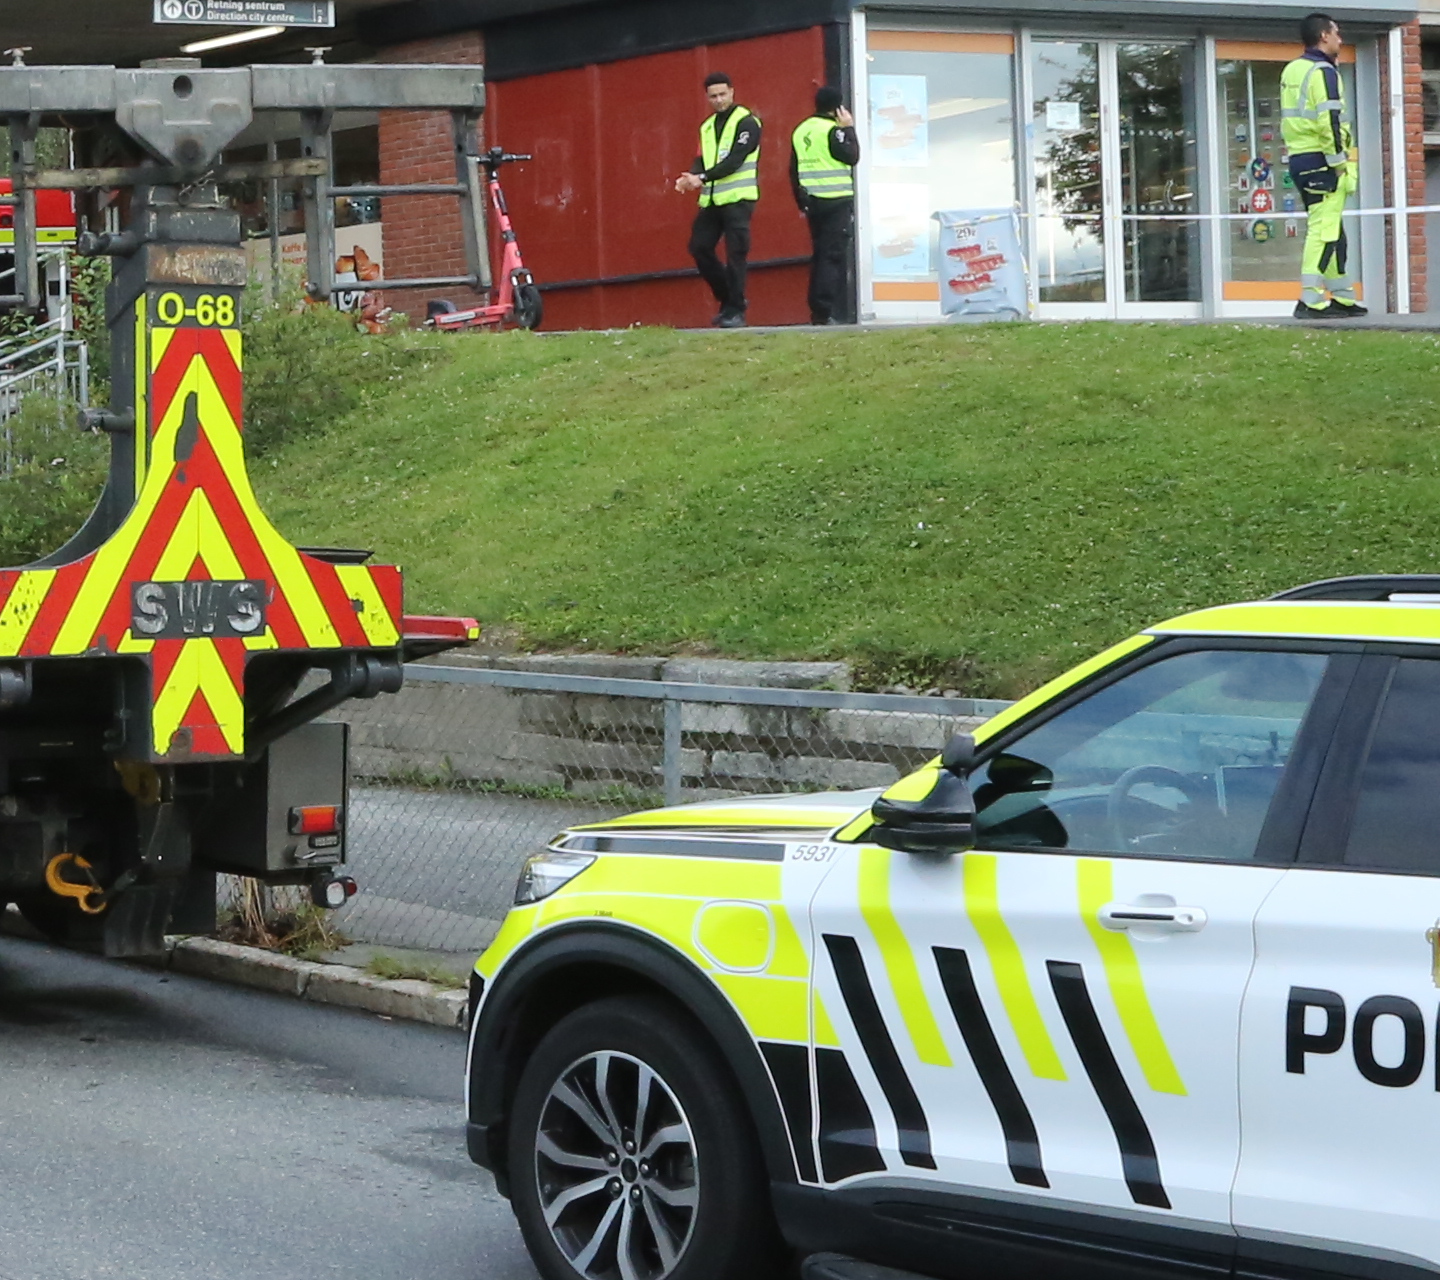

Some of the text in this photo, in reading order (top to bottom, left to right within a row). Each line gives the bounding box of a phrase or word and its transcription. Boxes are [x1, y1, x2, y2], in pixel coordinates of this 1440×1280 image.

[244, 1, 286, 12] sentrum
[206, 10, 296, 24] Direction city centre
[157, 291, 235, 327] O-68
[791, 844, 839, 863] 5931
